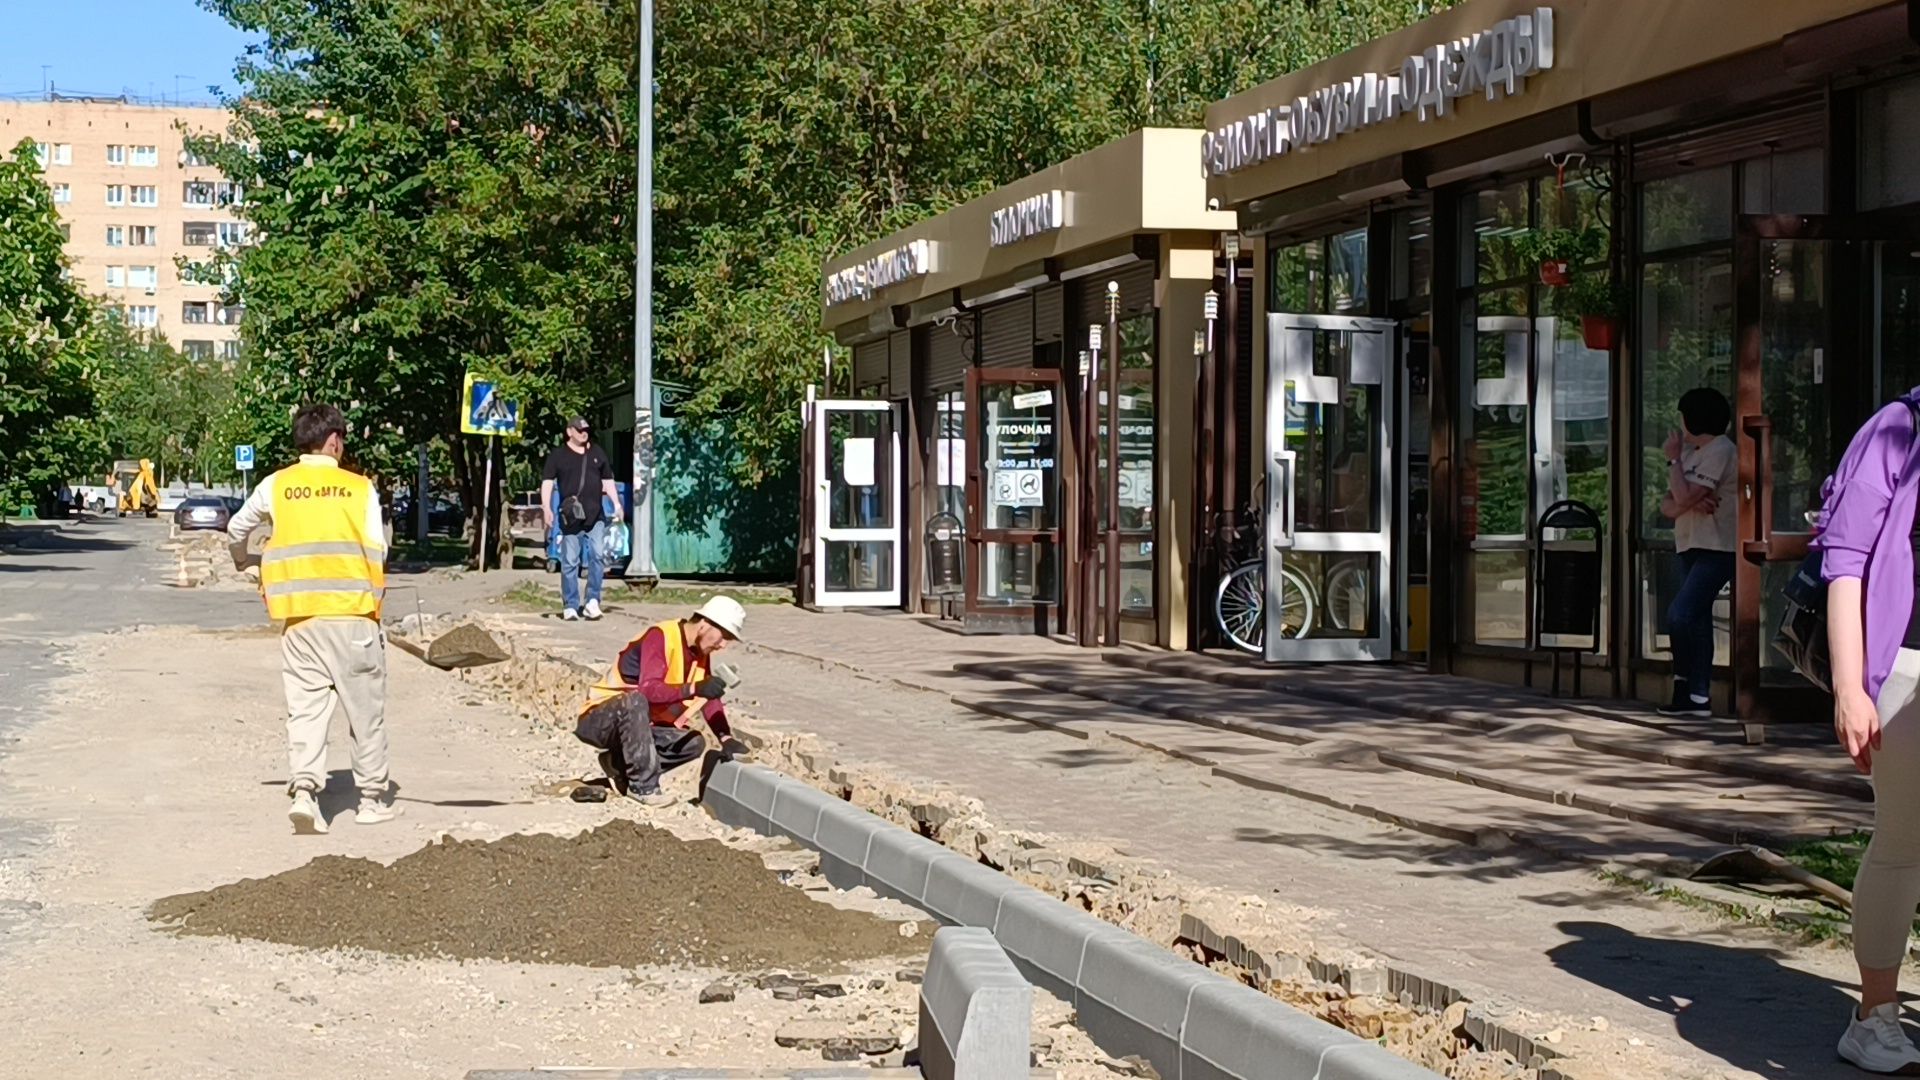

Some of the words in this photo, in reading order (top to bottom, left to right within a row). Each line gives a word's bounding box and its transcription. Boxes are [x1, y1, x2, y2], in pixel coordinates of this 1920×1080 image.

[1201, 106, 1291, 178] РЕМОНТ
[1288, 73, 1377, 150] ОБУВИ
[1400, 7, 1553, 122] ОДЕЖДЫ
[284, 486, 312, 500] ООО
